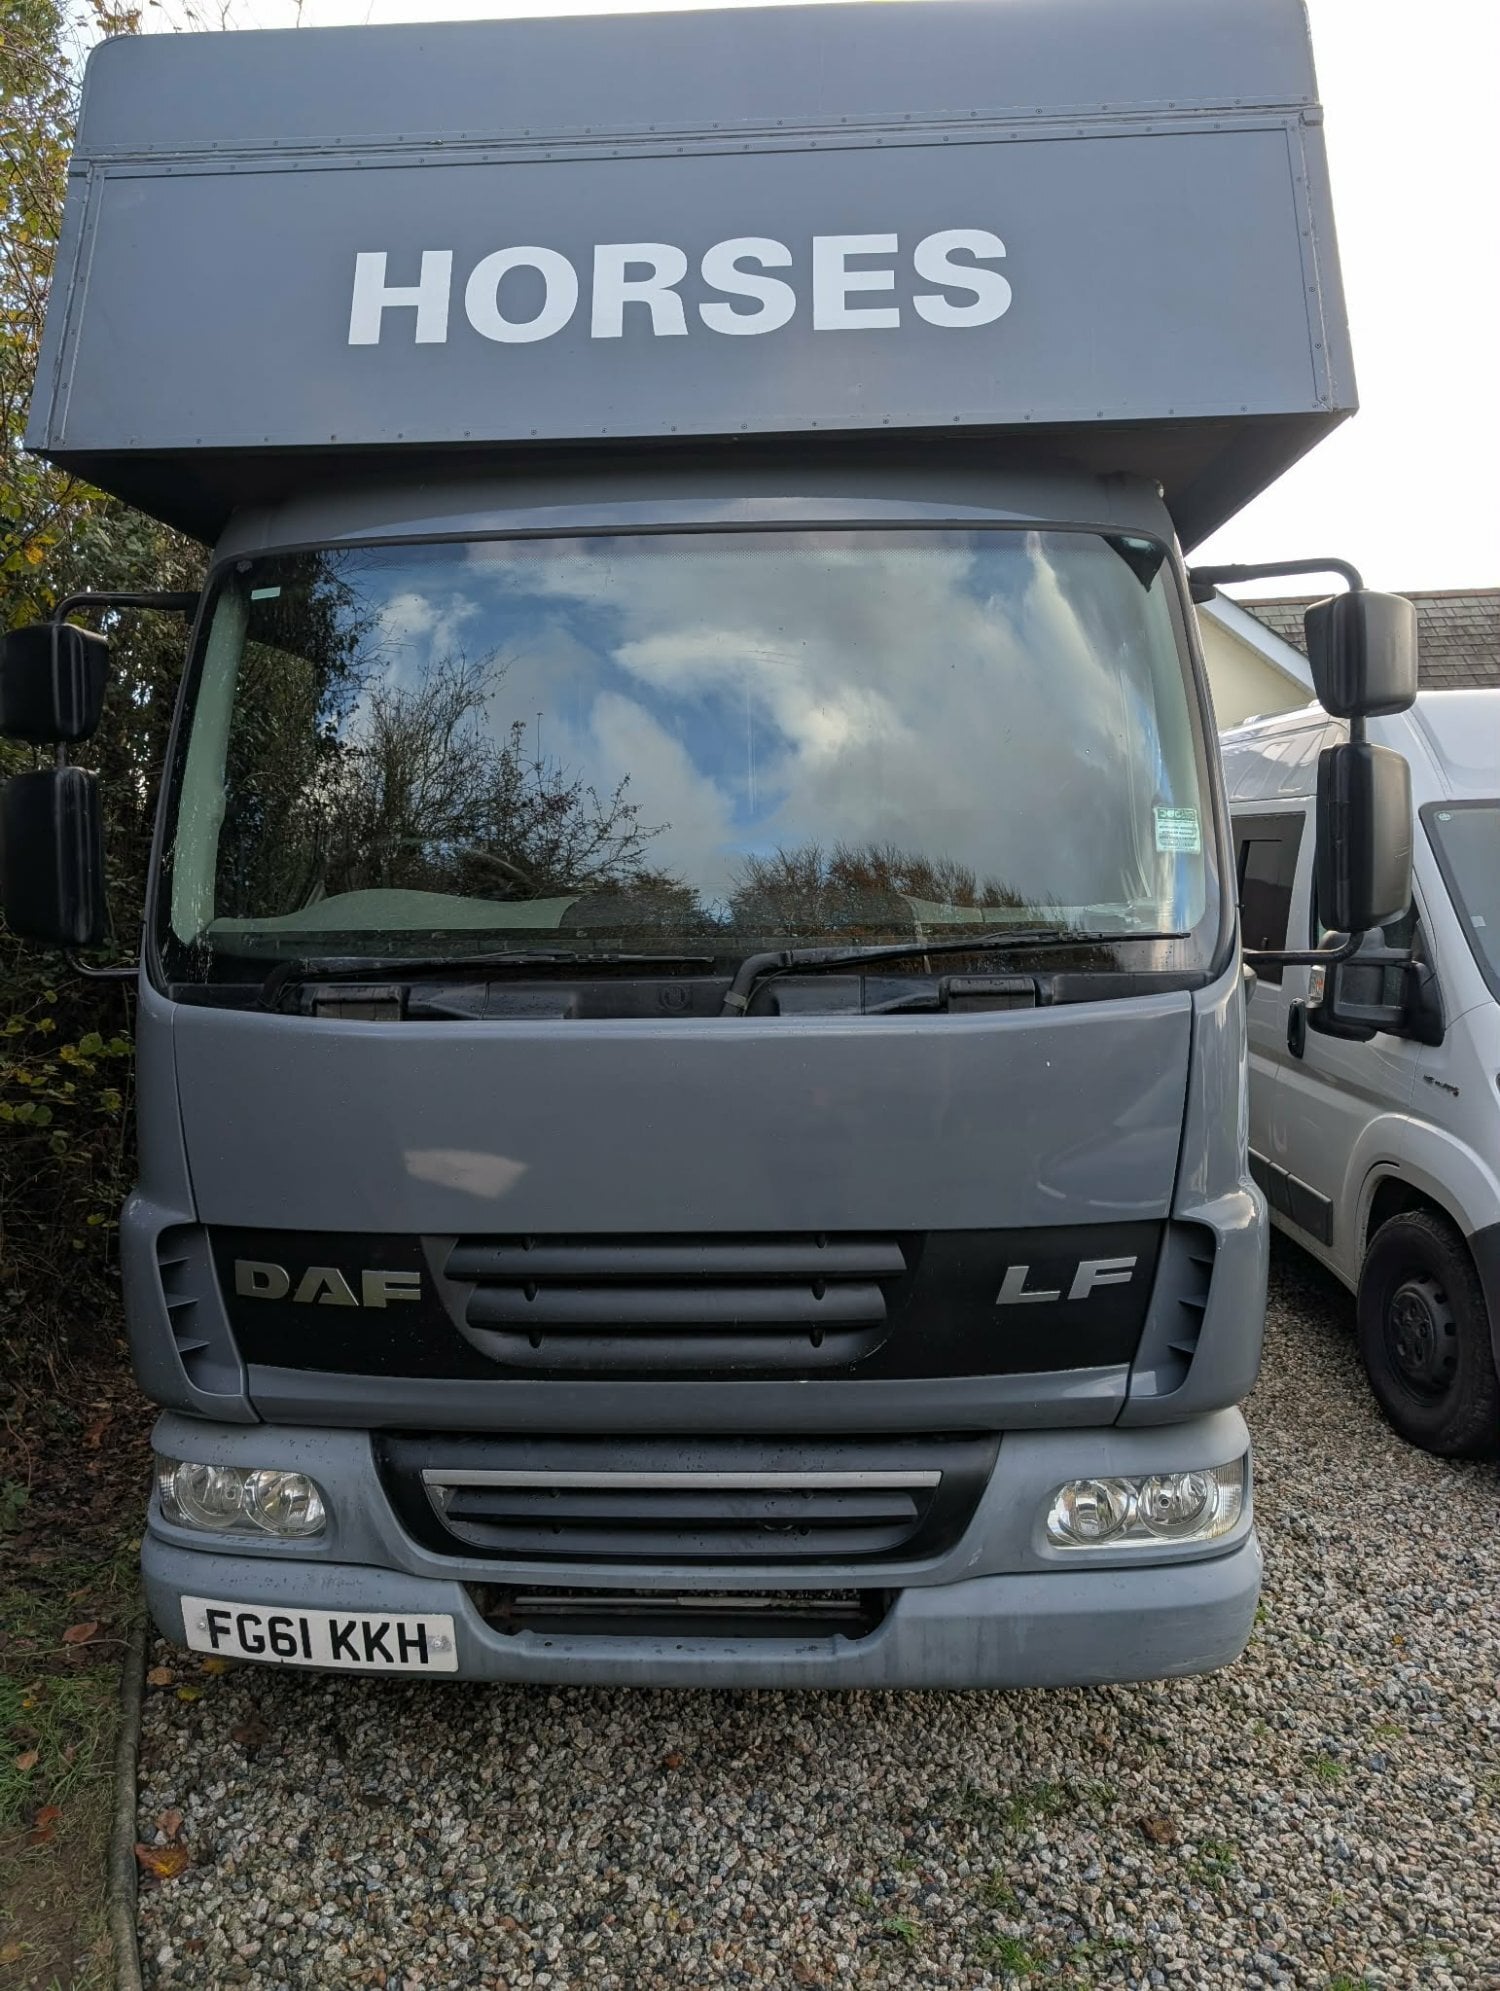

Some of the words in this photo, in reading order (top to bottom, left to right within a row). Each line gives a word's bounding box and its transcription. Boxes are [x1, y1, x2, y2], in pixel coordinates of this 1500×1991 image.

[348, 229, 1012, 345] HORSES
[235, 1259, 421, 1308] DAF
[996, 1256, 1138, 1304] LF
[206, 1608, 312, 1659] FG61
[329, 1619, 429, 1664] KKH
